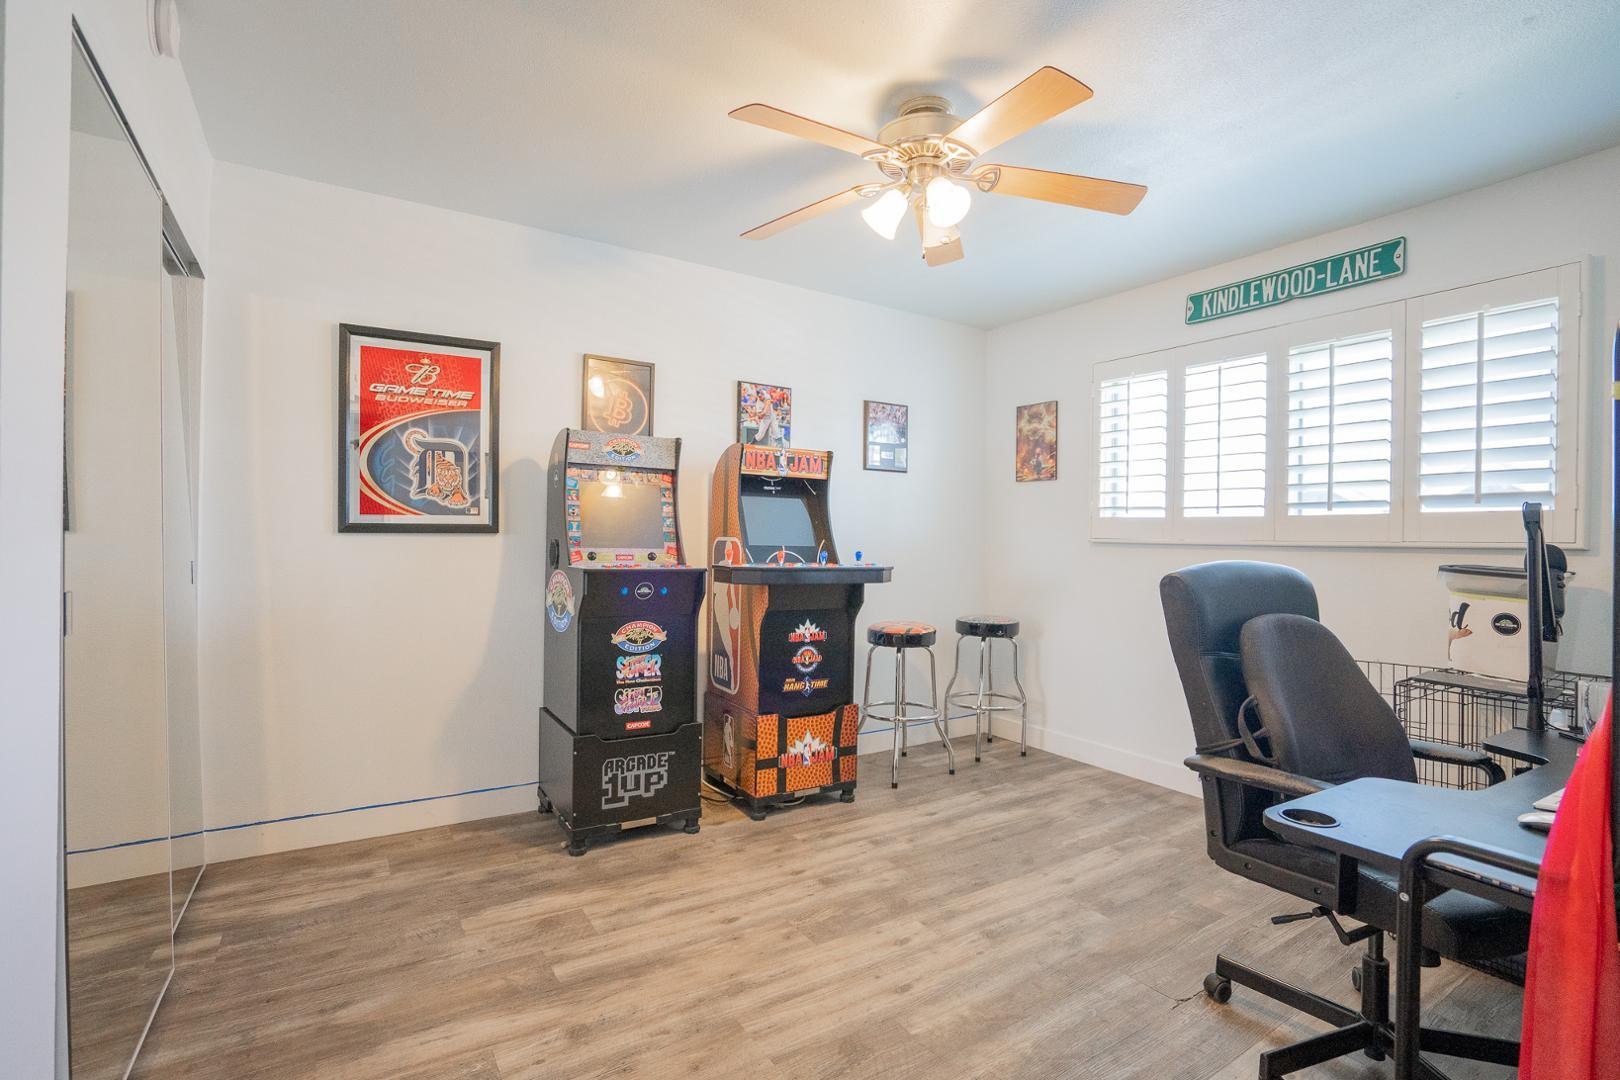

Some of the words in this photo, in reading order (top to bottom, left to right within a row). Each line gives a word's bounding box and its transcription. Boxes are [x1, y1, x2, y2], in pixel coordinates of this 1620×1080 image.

[1201, 247, 1382, 318] KINDLEWOOD-LANE
[369, 383, 428, 396] GAME
[430, 387, 475, 400] TIME
[374, 394, 468, 407] BUDWEISER
[745, 450, 777, 471] NBA
[788, 453, 822, 474] JAM
[621, 622, 656, 634] CHAMPION
[624, 641, 656, 652] EDITION
[715, 654, 729, 681] NBA
[783, 681, 805, 692] HANG
[810, 679, 828, 689] TIME
[602, 752, 668, 776] ARCADE
[780, 752, 803, 768] NBA
[810, 745, 834, 764] JAM
[602, 770, 668, 809] 1UP
